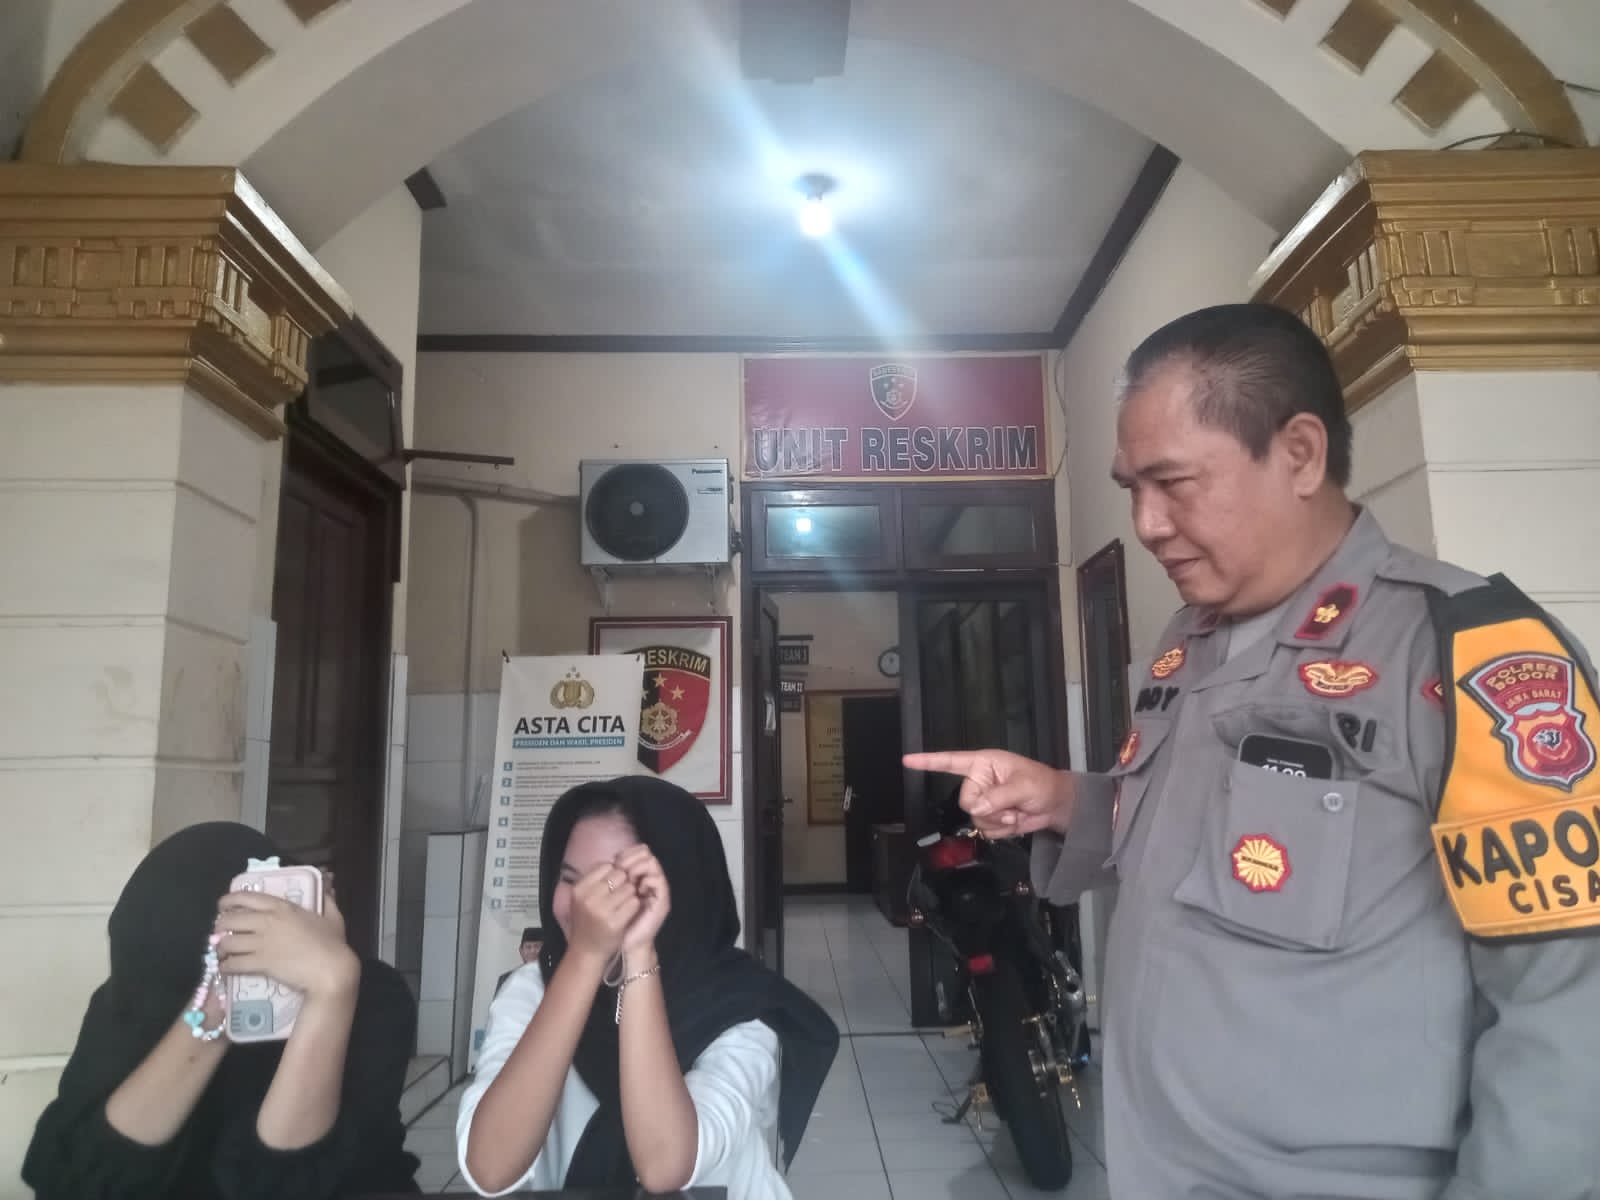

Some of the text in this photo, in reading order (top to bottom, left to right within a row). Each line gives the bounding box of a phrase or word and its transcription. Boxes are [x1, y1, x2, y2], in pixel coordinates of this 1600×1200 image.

[752, 425, 1039, 472] UNIT RESKRIM
[644, 648, 708, 673] ESKRIM
[1485, 662, 1559, 688] POLRES
[1494, 670, 1557, 691] BOGOR
[780, 681, 796, 692] TEAM
[1531, 688, 1562, 699] BARAT
[513, 715, 626, 735] ASTA CITA
[566, 738, 589, 746] WAKIL
[590, 737, 623, 746] PRESIDEN
[1441, 805, 1600, 889] KAPO
